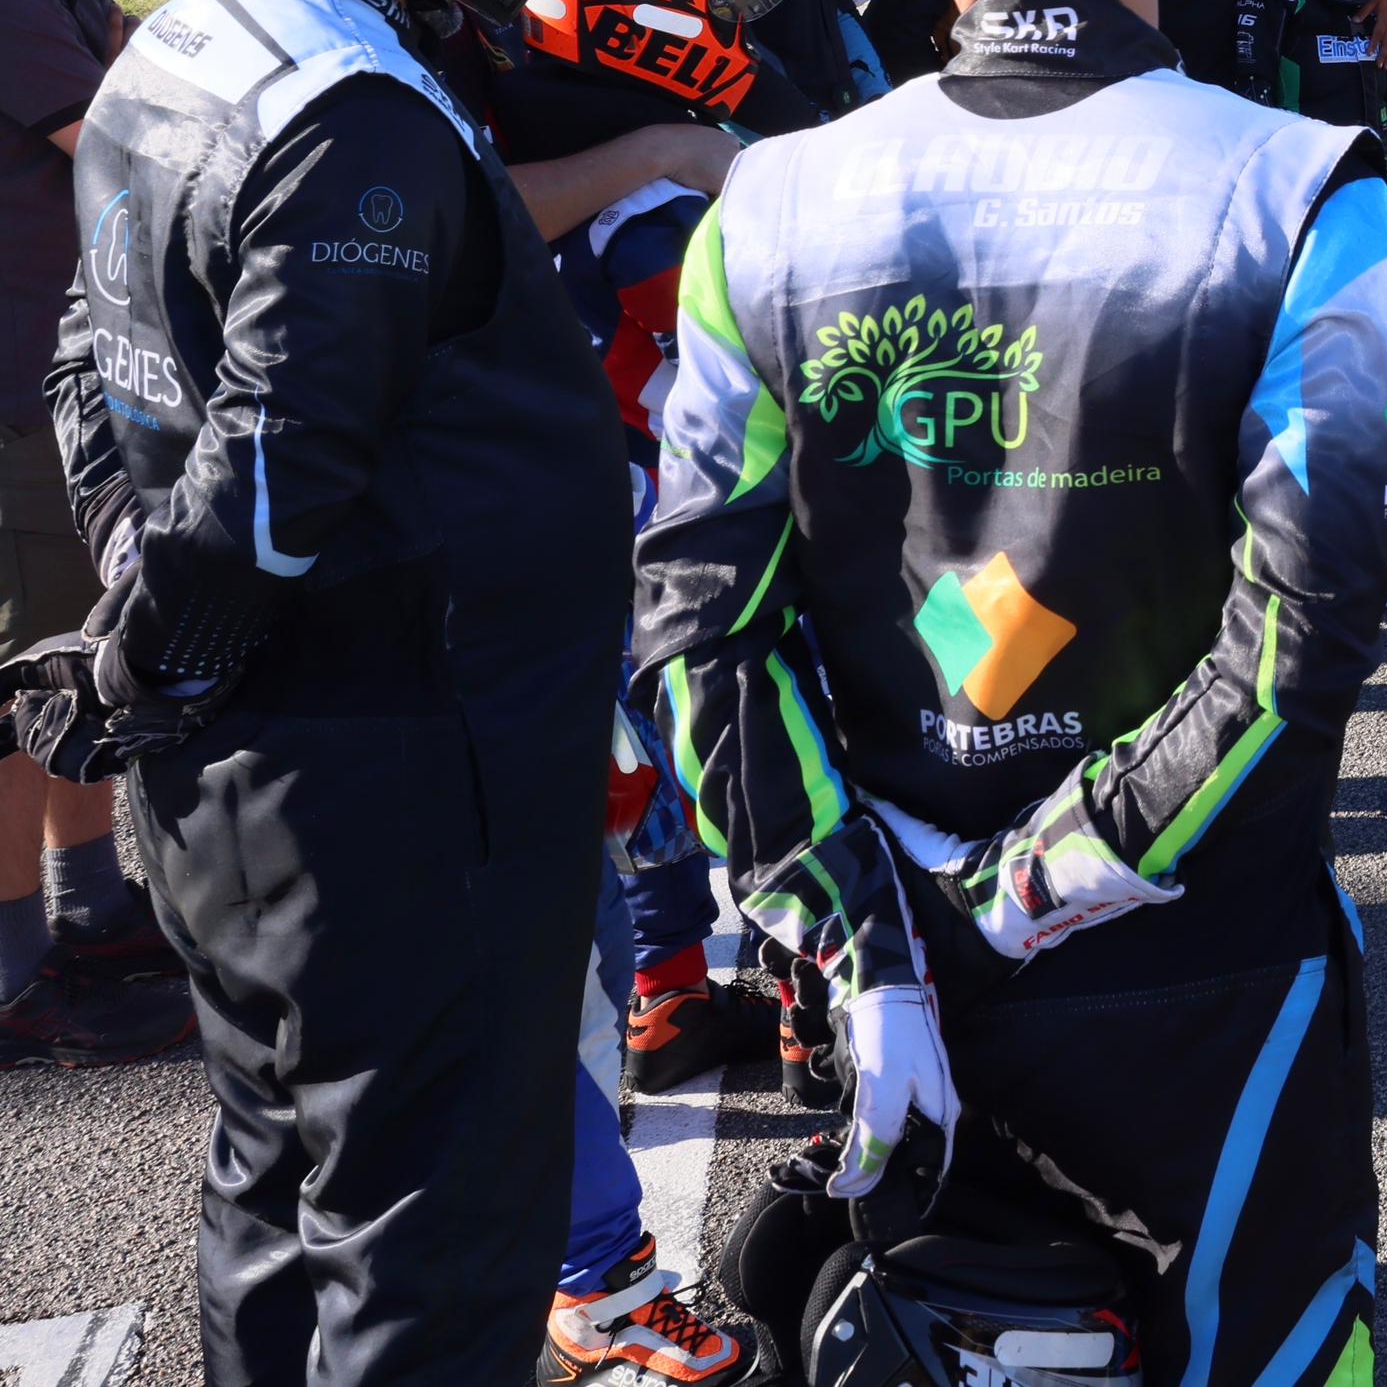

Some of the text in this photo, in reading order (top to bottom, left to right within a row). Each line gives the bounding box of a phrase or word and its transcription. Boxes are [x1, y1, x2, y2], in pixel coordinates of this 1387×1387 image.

[592, 6, 731, 94] BELL
[974, 42, 1075, 58] Style Kart Racing
[973, 197, 1149, 228] G. Santos
[311, 237, 430, 274] DIÓGENES
[895, 390, 1028, 449] GPU
[948, 464, 1161, 489] Portas de madeira
[920, 708, 1083, 752] PORTEBRAS
[923, 736, 950, 763] PORTAS
[961, 736, 1086, 767] COMPENSADOS
